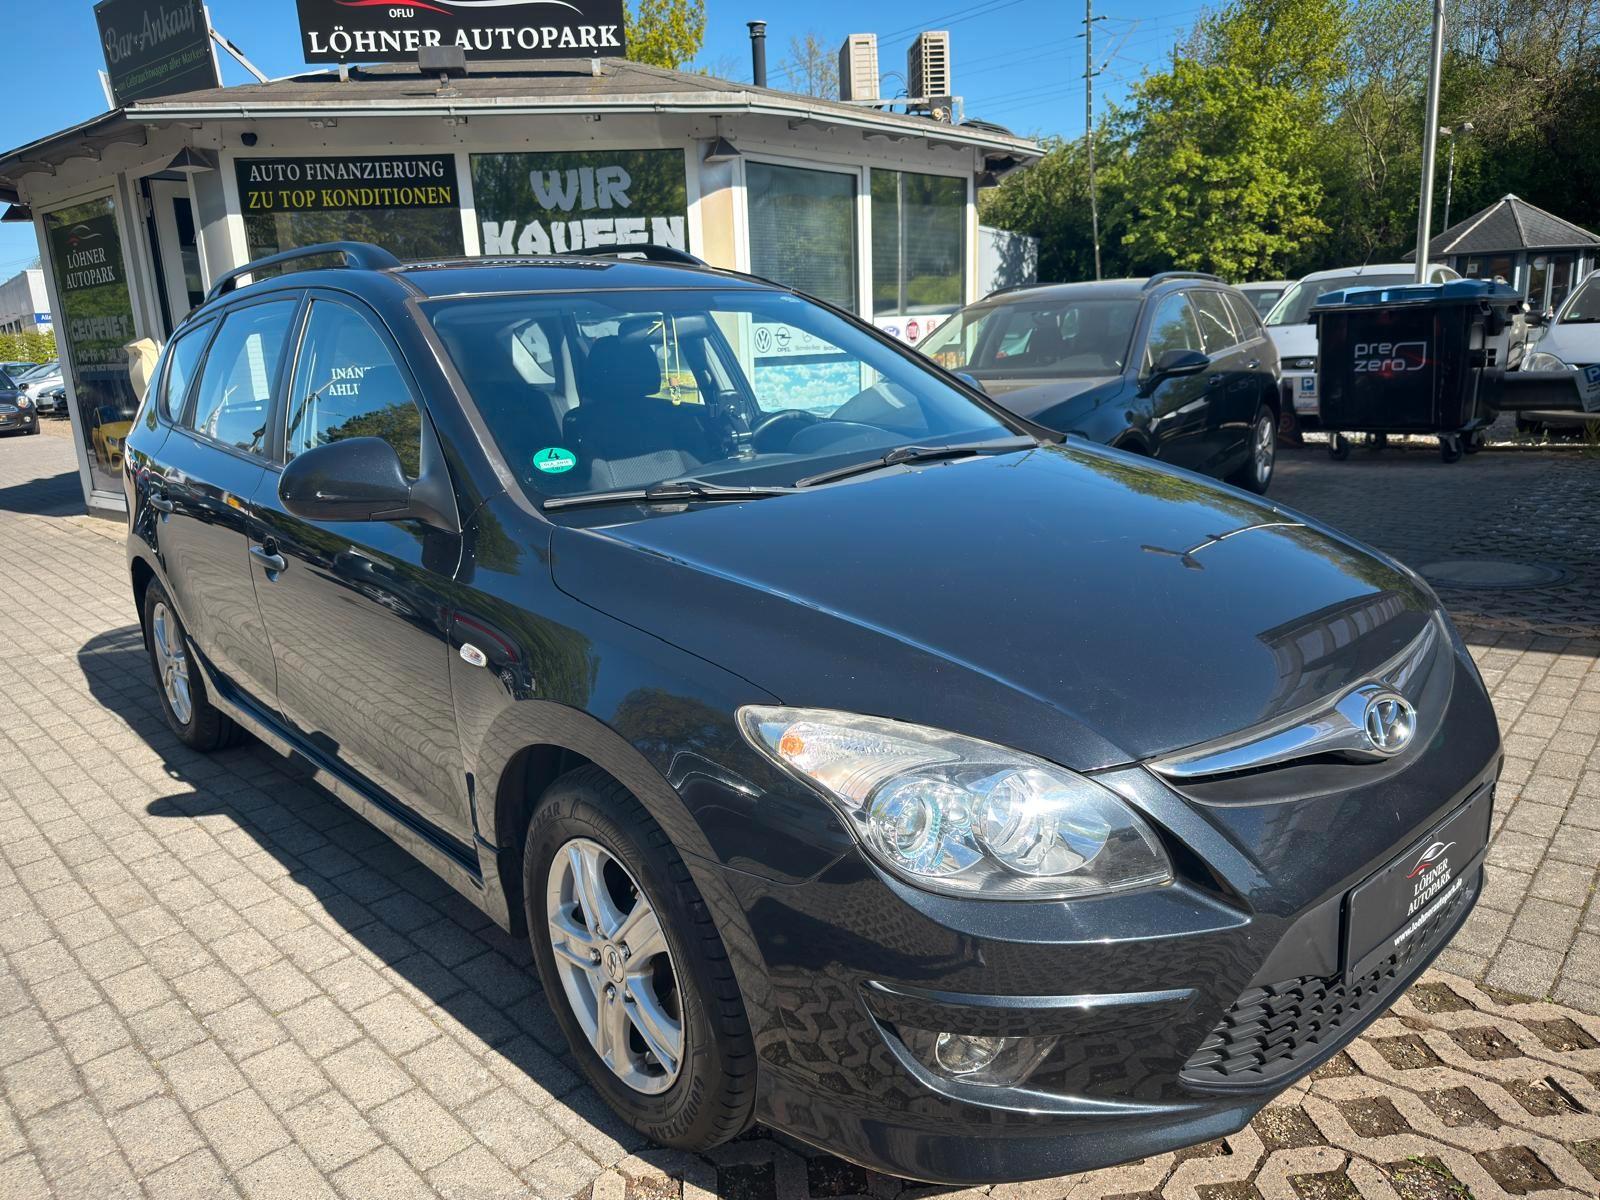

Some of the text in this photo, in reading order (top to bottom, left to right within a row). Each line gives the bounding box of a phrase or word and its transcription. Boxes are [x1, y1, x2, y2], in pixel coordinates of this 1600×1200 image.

[388, 8, 415, 18] OFLU
[307, 25, 622, 53] LÖHNER AUTOPARK
[249, 160, 445, 182] AUTO FINANZIERUNG
[248, 186, 452, 209] ZU TOP KONDITIONEN
[529, 165, 633, 212] WIR
[482, 215, 686, 255] KAUFEN
[66, 247, 107, 269] LÖHNER
[66, 265, 116, 289] AUTOPARK
[1354, 342, 1392, 358] pre
[1354, 358, 1406, 372] zero
[1303, 378, 1314, 391] P
[547, 448, 560, 460] 4
[1413, 858, 1449, 897] LÖHNER
[1407, 868, 1452, 917] AUTOPARK
